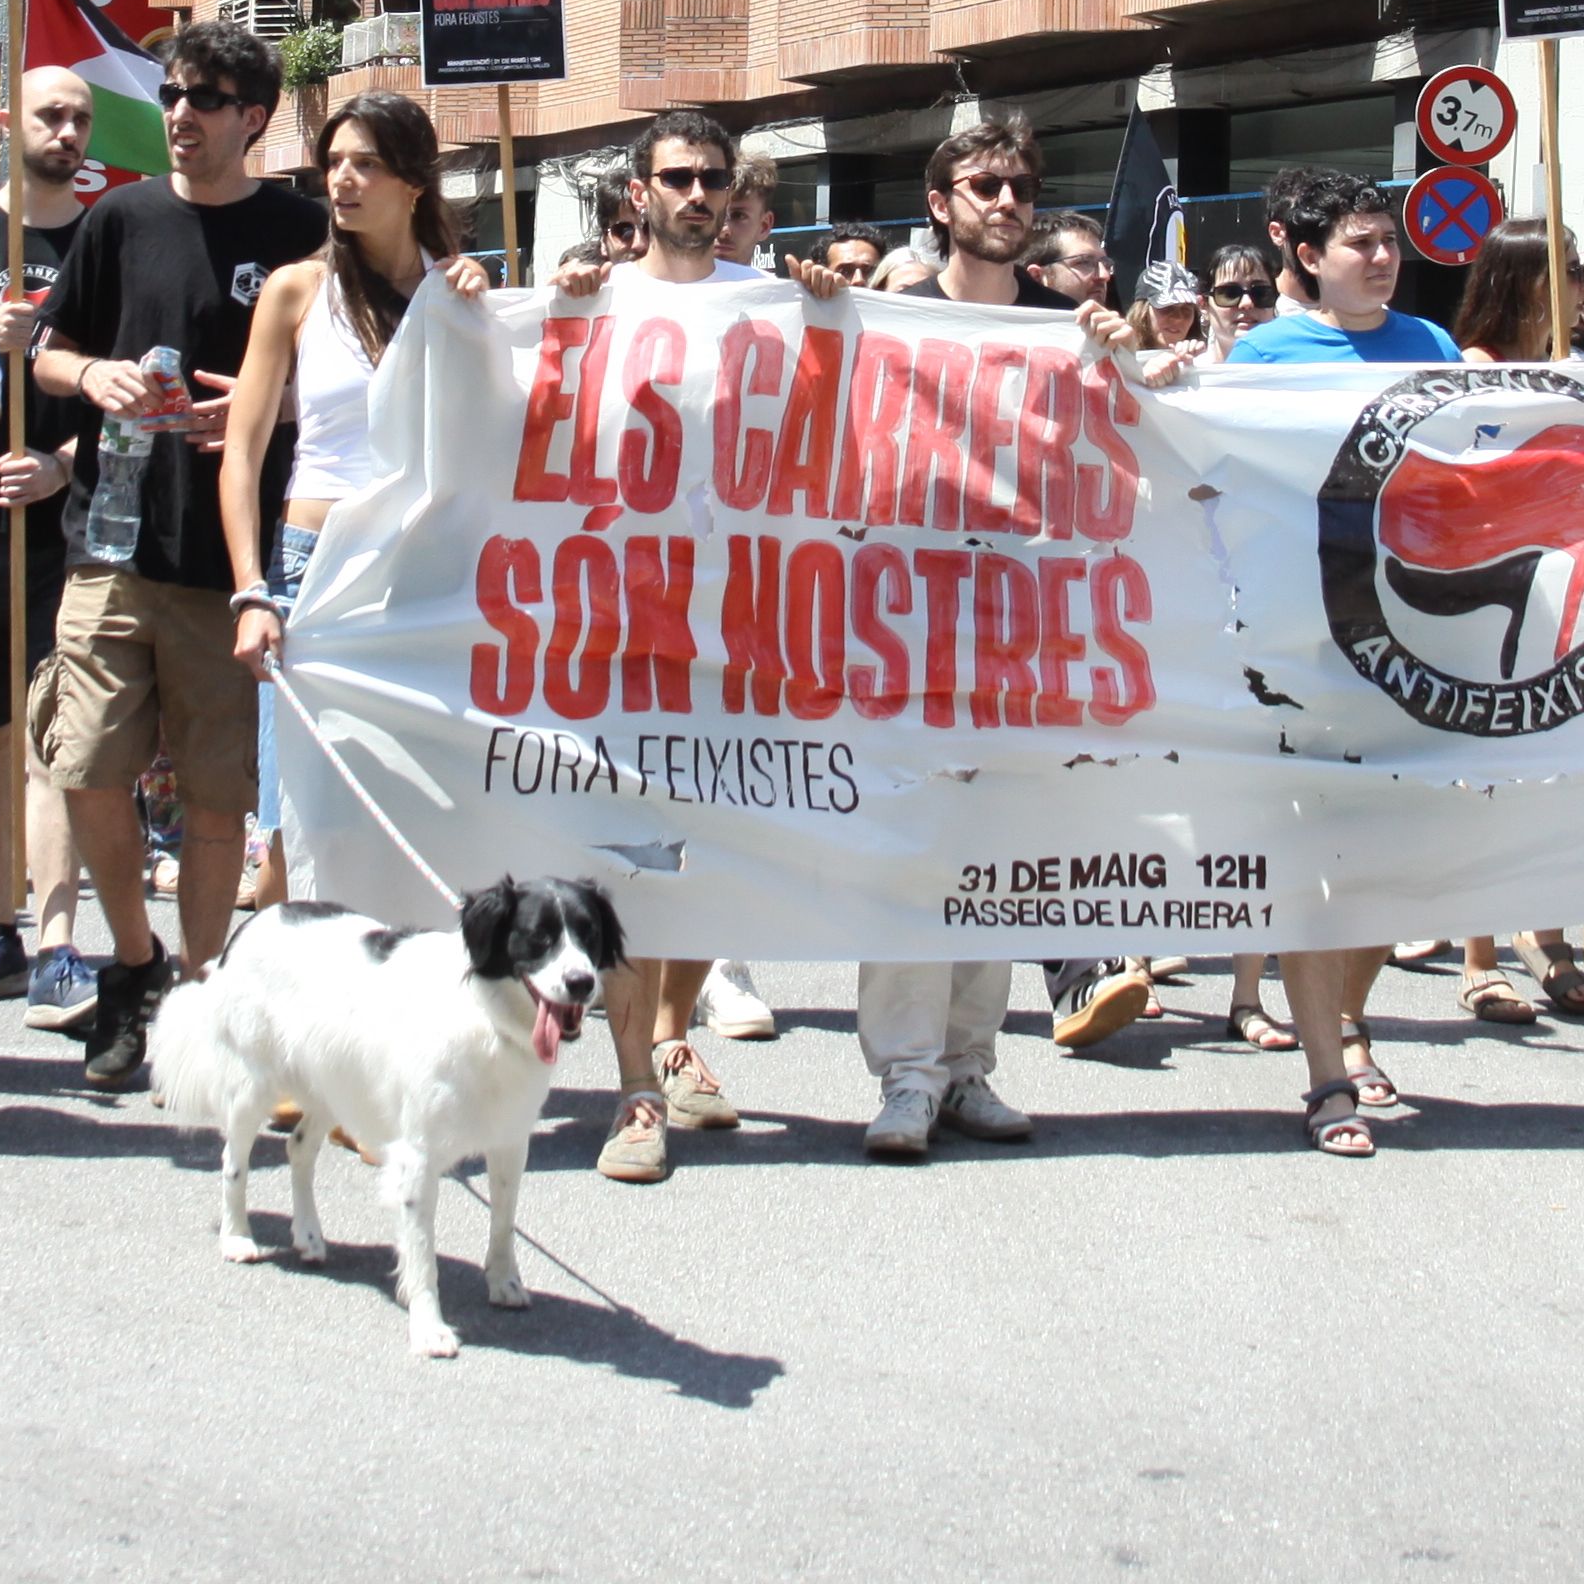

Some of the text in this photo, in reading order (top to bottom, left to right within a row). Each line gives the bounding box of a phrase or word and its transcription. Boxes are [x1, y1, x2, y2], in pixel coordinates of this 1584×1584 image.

[434, 11, 500, 27] FORA FEIXISTES
[512, 315, 1143, 542] ELS CARRERS
[471, 504, 1154, 729] SÓN NOSTRES
[484, 726, 859, 813] FORA FEIXISTES
[959, 853, 1267, 893] 31 DE MAIG 12H
[944, 897, 1273, 929] PASSEIG DE LA RIERA 1
